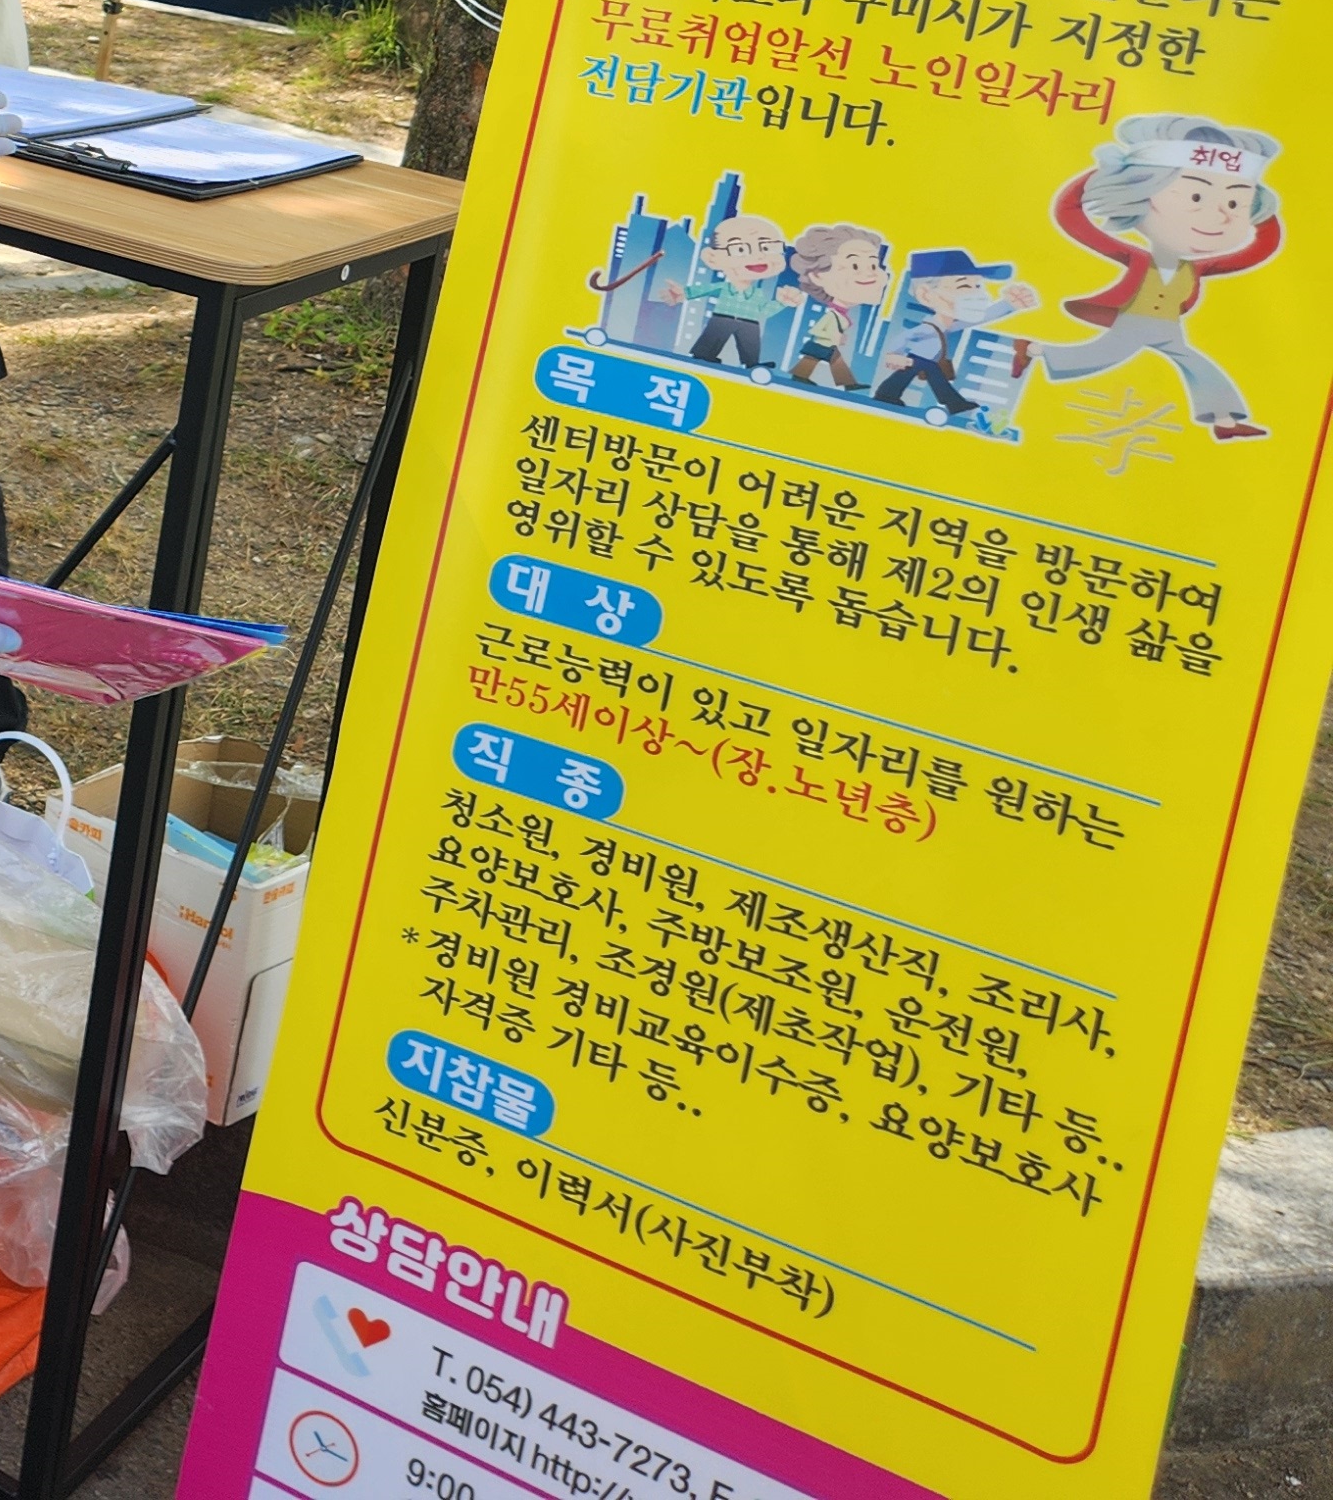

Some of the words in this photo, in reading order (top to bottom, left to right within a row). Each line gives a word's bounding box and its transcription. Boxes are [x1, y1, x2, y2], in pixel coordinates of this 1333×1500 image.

[581, 55, 896, 148] 전담기관입니다.
[592, 0, 852, 78] 무료취업알선
[870, 48, 1117, 125] 노인일자리
[1052, 15, 1205, 76] 지정한
[1190, 144, 1243, 171] 취업
[508, 498, 624, 560] 영위할
[634, 533, 675, 572] 수
[691, 548, 816, 614] 있도록
[829, 587, 1019, 674] 돕습니다.
[516, 457, 630, 517] 일자리
[643, 490, 766, 552] 상담을
[782, 525, 867, 582] 통해
[885, 555, 998, 617] 제2의
[1022, 591, 1109, 648] 인생
[1127, 621, 1223, 677] 삶을
[522, 415, 721, 496] 센터방문이
[738, 463, 865, 532] 어려운
[880, 504, 1018, 570] 지역을
[1037, 543, 1223, 626] 방문하여
[475, 623, 673, 712] 근로능력이
[692, 687, 773, 740] 있고
[790, 717, 969, 801] 일자리를
[984, 775, 1126, 852] 원하는
[428, 837, 629, 933] 요양보호사,
[648, 908, 864, 1018] 주방보조원,
[884, 994, 1029, 1079] 운전원,
[442, 788, 560, 861] 청소원,
[580, 839, 705, 913] 경비원,
[726, 886, 949, 996] 제조생산직,
[967, 972, 1117, 1058] 조리사,
[401, 1037, 539, 1127] 지참물
[420, 879, 578, 963] 주차관리,
[599, 941, 927, 1097] 조경원(제초작업),
[951, 1074, 1042, 1136] 기타
[1053, 1107, 1125, 1172] 등..
[421, 976, 536, 1045] 자격증
[547, 1026, 628, 1086] 기타
[638, 1056, 702, 1118] 등..
[551, 978, 850, 1124] 경비교육이수증,
[871, 1103, 1102, 1219] 요양보호사
[329, 1200, 566, 1349] 상담안내
[375, 1098, 495, 1177] 신분증,
[516, 1156, 835, 1319] 이력서(사진부착)
[406, 1458, 475, 1500] 9:00
[422, 1390, 525, 1463] 홈페이지
[431, 1346, 457, 1384] T.
[467, 1364, 534, 1419] 054)
[538, 1403, 697, 1500] 443-7273,
